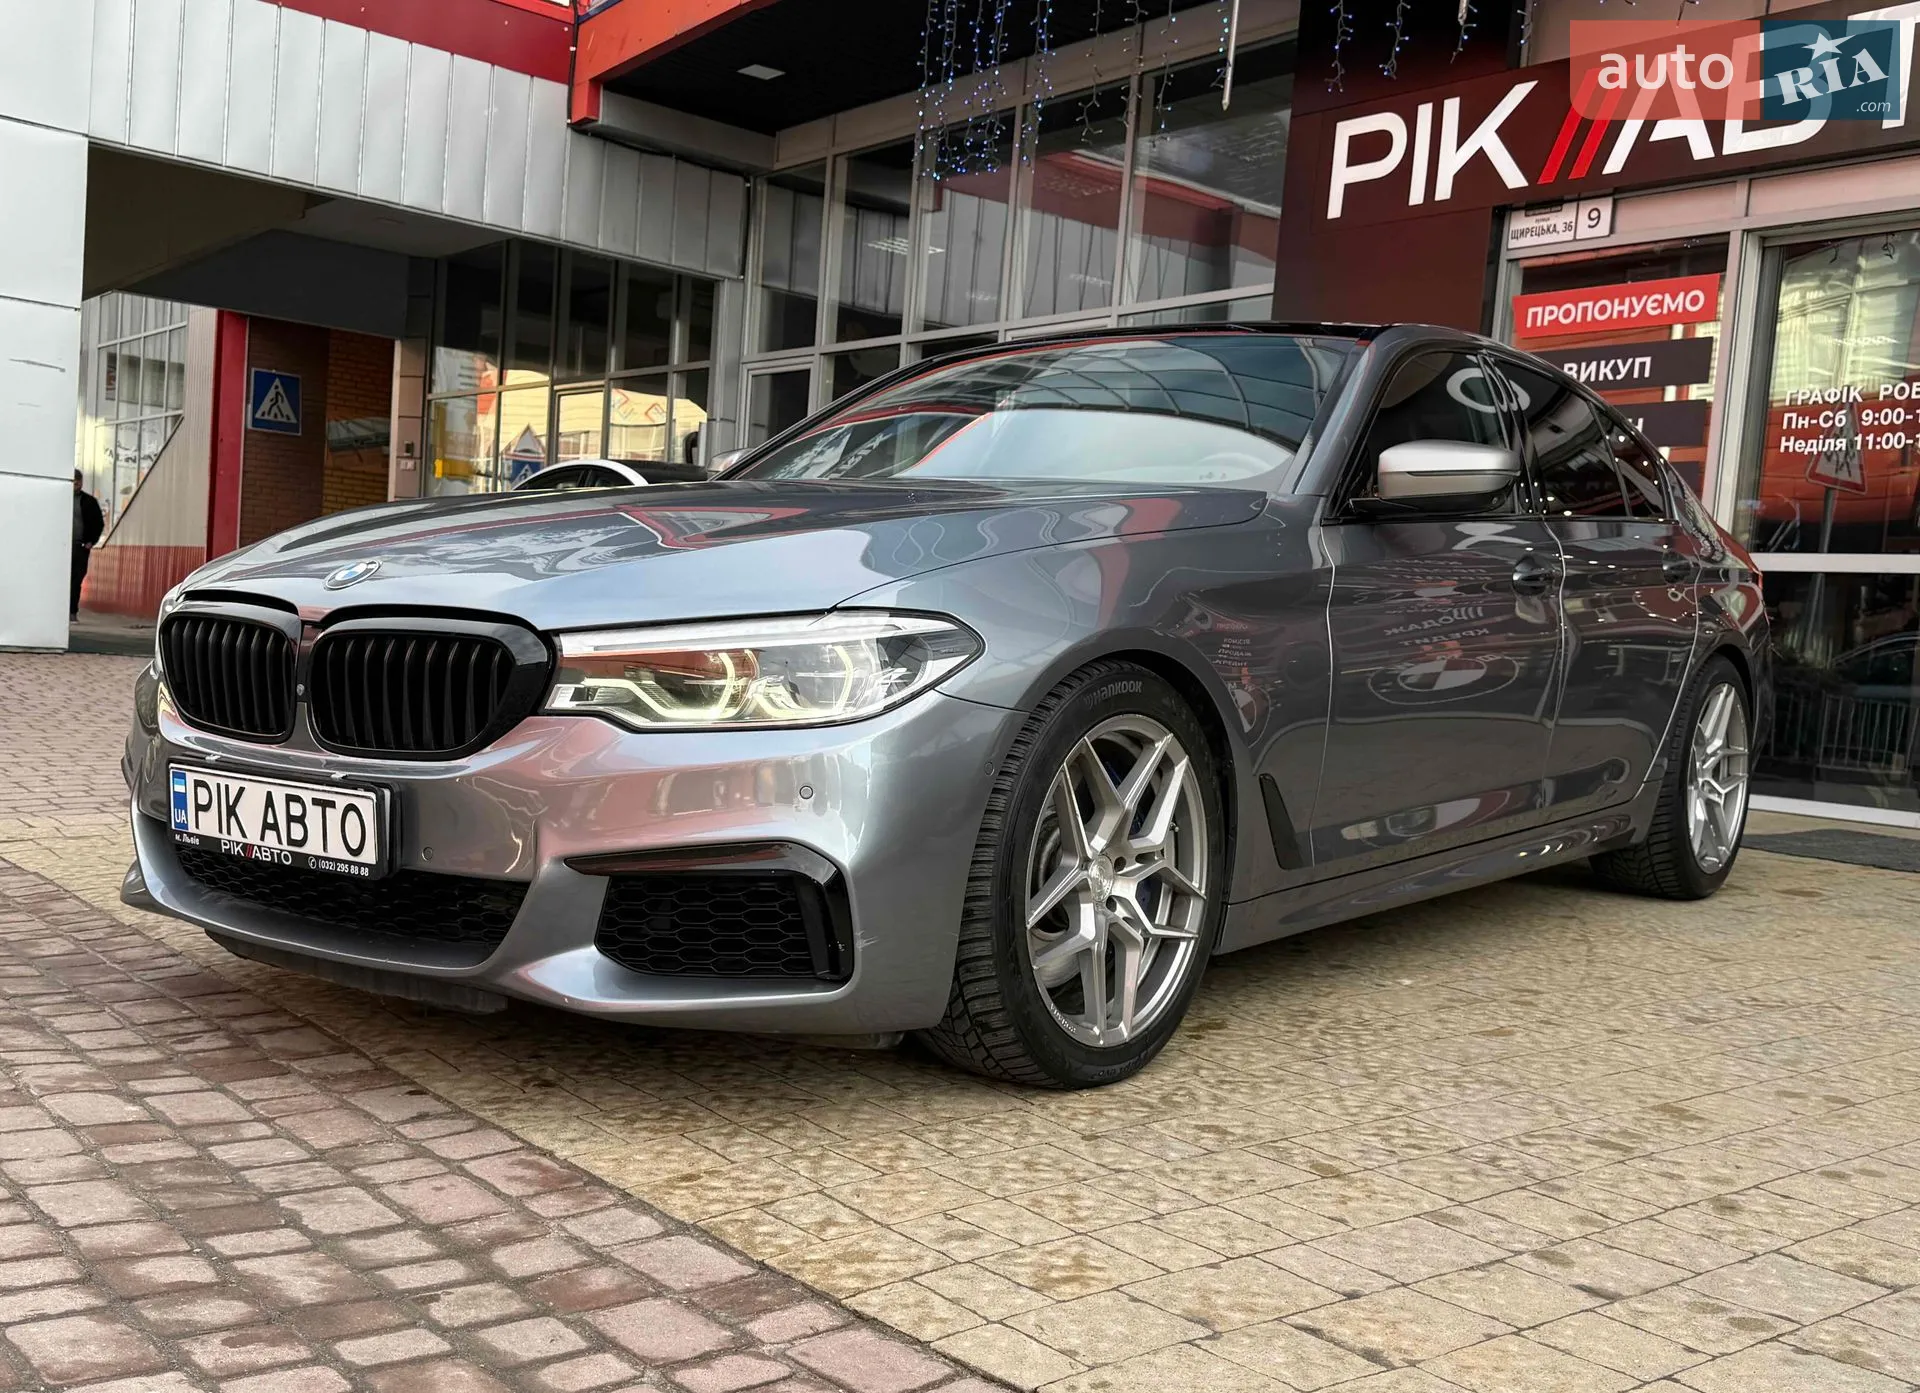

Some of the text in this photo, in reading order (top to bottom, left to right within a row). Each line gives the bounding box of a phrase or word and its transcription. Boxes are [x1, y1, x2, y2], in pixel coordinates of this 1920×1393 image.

[1587, 207, 1602, 229] 9
[1510, 221, 1573, 241] ЩИРЕЦЬКА, 36
[1526, 289, 1706, 329] ПРОПОНУЄМО
[1562, 356, 1652, 383] ВИКУП
[1784, 385, 1865, 406] ГРАФІК
[1782, 409, 1848, 430] Пн-Сб
[1780, 434, 1847, 456] Неділя
[174, 808, 188, 825] UA
[318, 859, 369, 877] (032) 295 88 88
